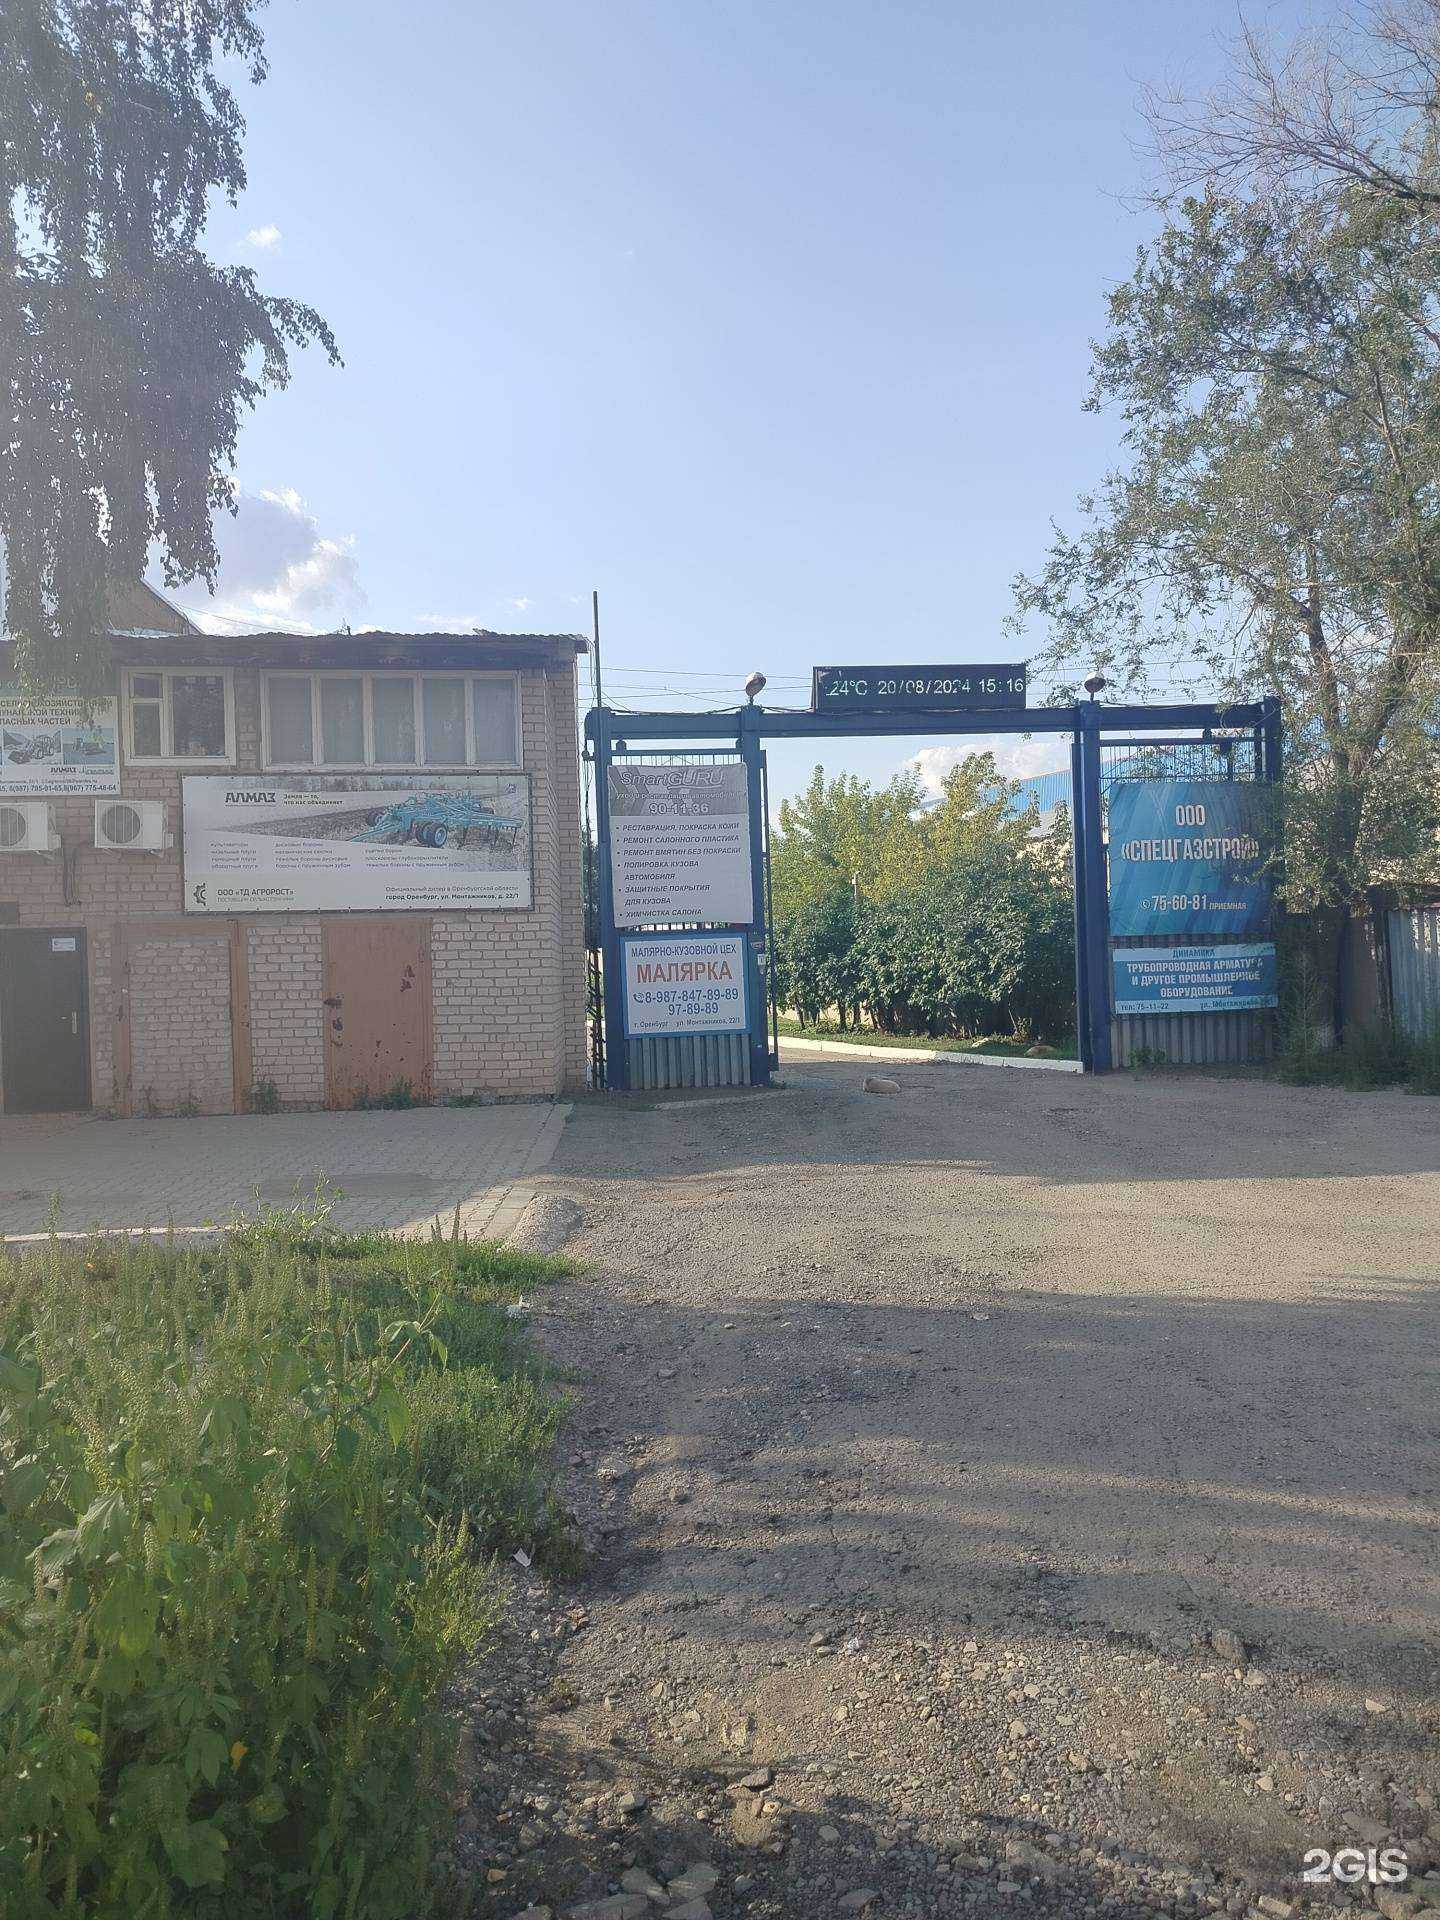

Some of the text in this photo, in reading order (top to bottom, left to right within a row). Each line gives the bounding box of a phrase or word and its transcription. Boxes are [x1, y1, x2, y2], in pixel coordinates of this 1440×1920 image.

[39, 717, 71, 725] ЧАСТЕЙ
[620, 768, 724, 786] SmartGURU
[225, 792, 277, 803] АЛМАЗ
[649, 803, 709, 815] 90-11-36
[1175, 804, 1206, 826] ООО
[622, 822, 740, 832] РЕСТАВРАЦИЯ, ПОКРАСКА КОЖИ
[701, 834, 740, 842] ПЛАСТИКА
[655, 848, 686, 856] ВМЯТИН
[702, 847, 741, 855] ПОКРАСКИ
[623, 860, 699, 869] ПОЛИРОВКА КУЗОВА
[625, 873, 676, 881] АВТОМОБИЛЯ
[217, 888, 294, 896] ООО «ТД АГРОРОСТ»
[625, 884, 711, 893] ЗАЩИТНЫЕ ПОКРЫТИЯ
[406, 893, 440, 901] Оренбург,
[642, 897, 671, 905] КУЗОВА
[1151, 894, 1247, 912] 75-60-81 ПРИЕМНАЯ
[626, 908, 703, 918] ХИМЧИСТКА САЛОНА
[631, 943, 737, 958] МАЛЯРНО-КУЗОВНОЙ ЦЕХ
[1172, 948, 1216, 959] ДИНАМИКА
[1127, 960, 1211, 973] ТРУБОПРОВОДНАЯ
[636, 961, 733, 984] МАЛЯРКА
[1131, 971, 1261, 987] И ДРУГОЕ ПРОМЫШЛЕННОЕ
[645, 988, 739, 1004] 8-987-847-89-89
[1160, 985, 1233, 998] ОБОРУДОВАНИЕ
[668, 1002, 719, 1016] 97-89-89
[1136, 1002, 1169, 1010] 75-11-22
